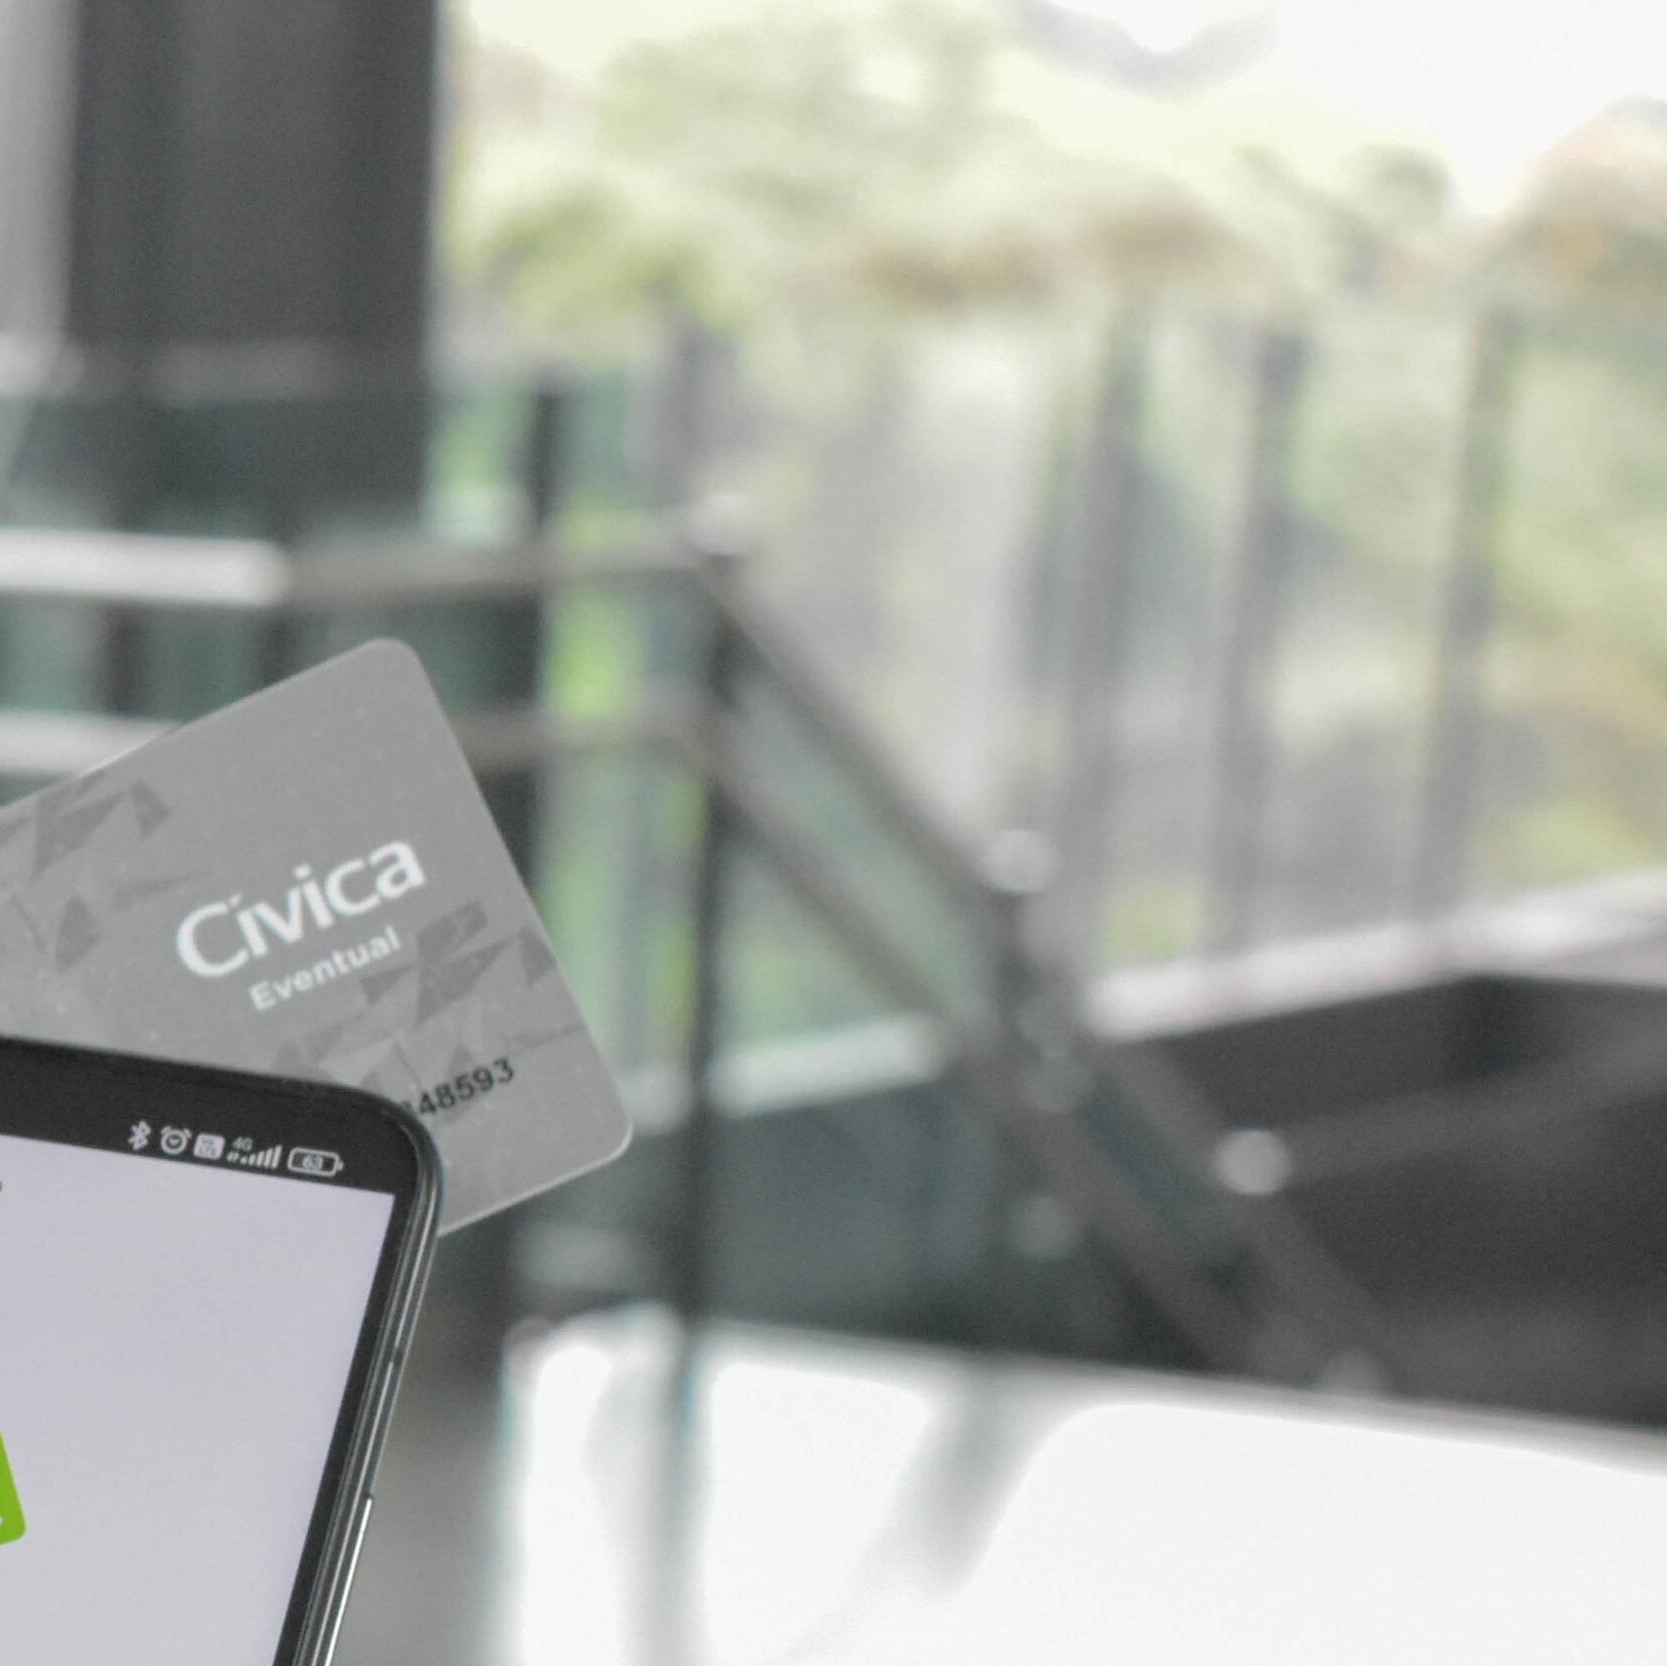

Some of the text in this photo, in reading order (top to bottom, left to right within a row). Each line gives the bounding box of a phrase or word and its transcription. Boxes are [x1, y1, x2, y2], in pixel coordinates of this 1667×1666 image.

[176, 840, 427, 978] Cívica
[248, 925, 402, 1012] Eventual
[402, 1057, 515, 1115] 48593
[232, 1136, 254, 1151] 4G
